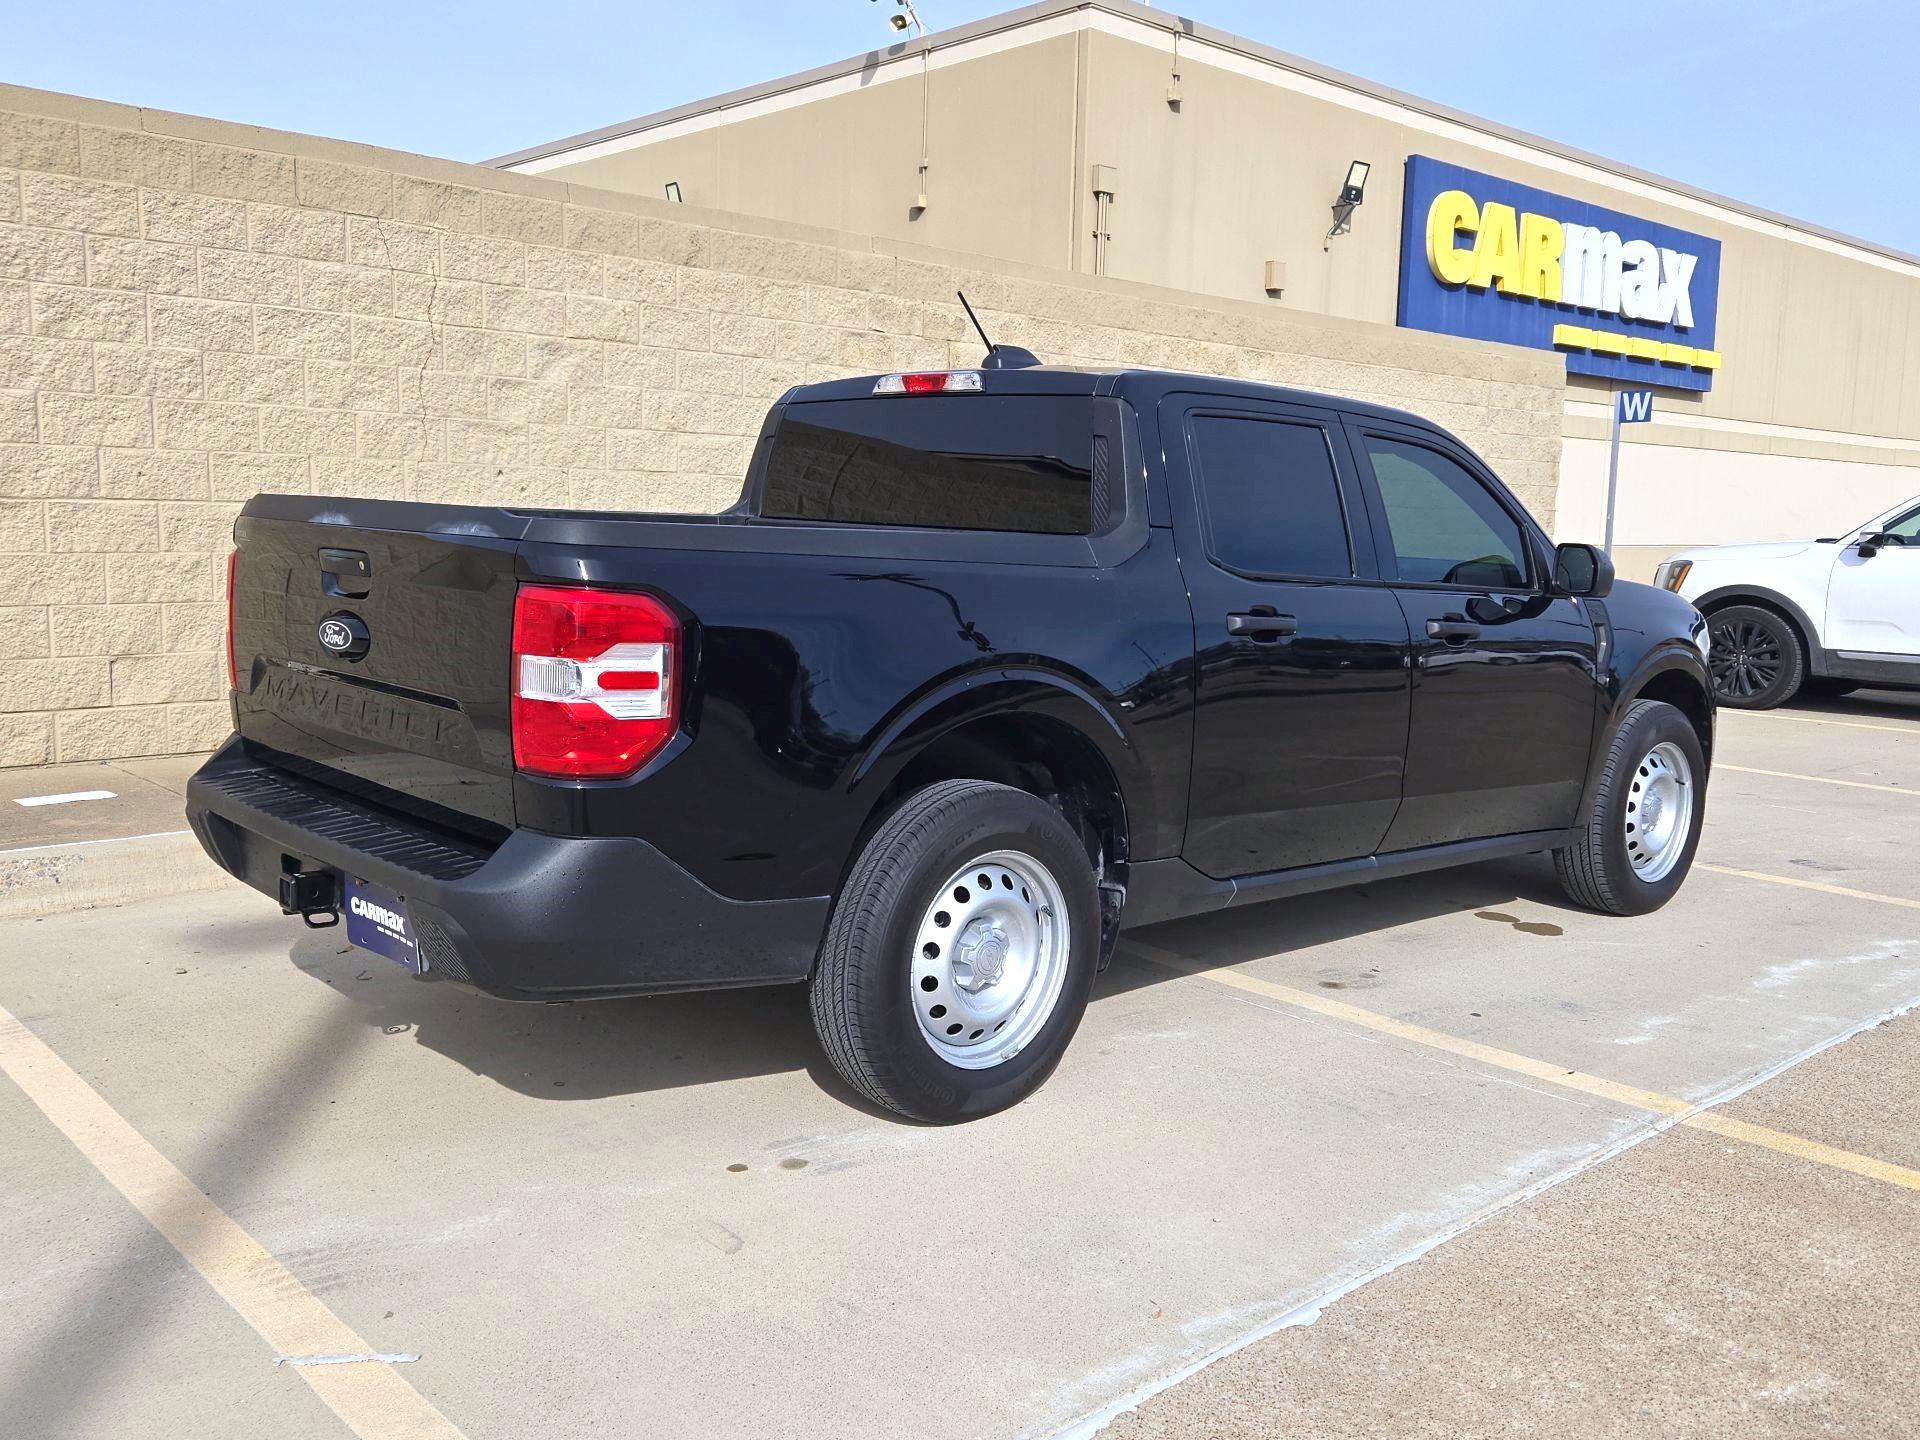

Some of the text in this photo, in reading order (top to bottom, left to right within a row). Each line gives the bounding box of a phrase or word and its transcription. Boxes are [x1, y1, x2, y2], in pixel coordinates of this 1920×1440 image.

[1426, 190, 1698, 328] CARmax
[1622, 391, 1652, 421] W
[324, 624, 345, 646] Ford
